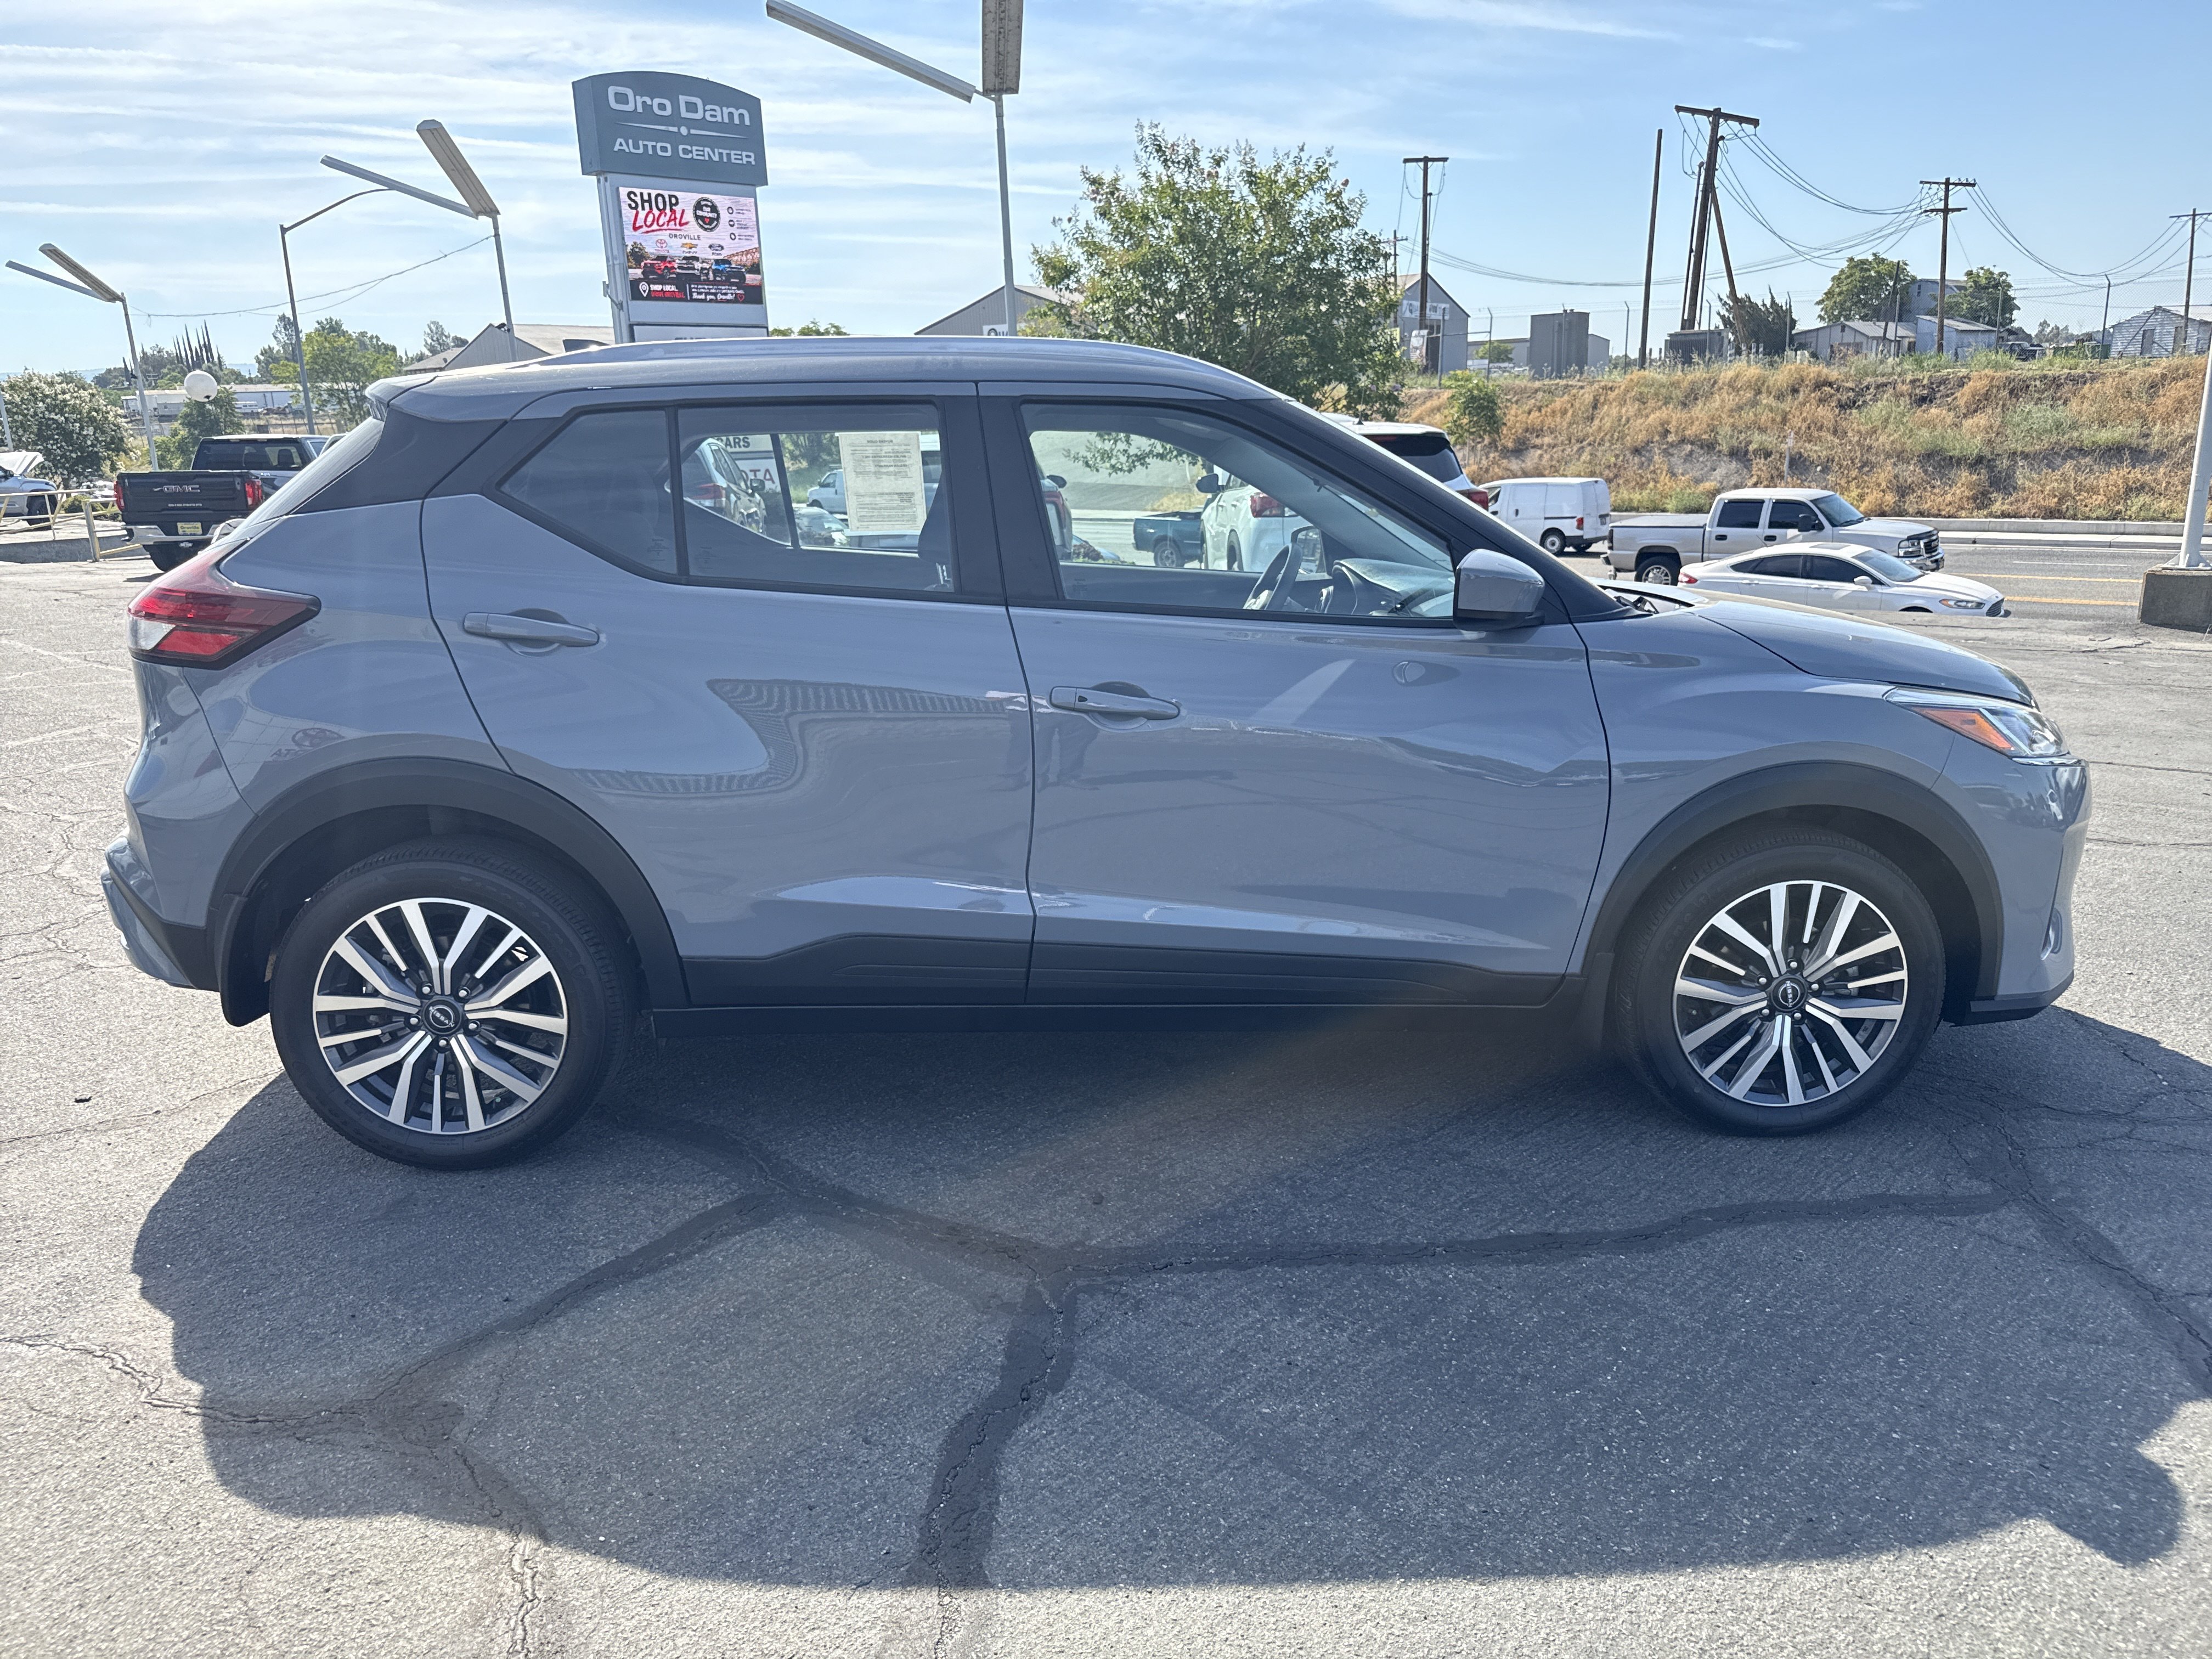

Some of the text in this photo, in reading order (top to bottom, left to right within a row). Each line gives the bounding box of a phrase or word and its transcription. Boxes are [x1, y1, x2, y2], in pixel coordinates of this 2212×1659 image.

[607, 86, 751, 126] Oro Dam
[613, 138, 755, 165] AUTO CENTER
[627, 190, 679, 212] SHOP
[632, 208, 690, 232] LOCAL
[163, 485, 200, 493] GMC
[428, 1006, 455, 1028] NISSAN
